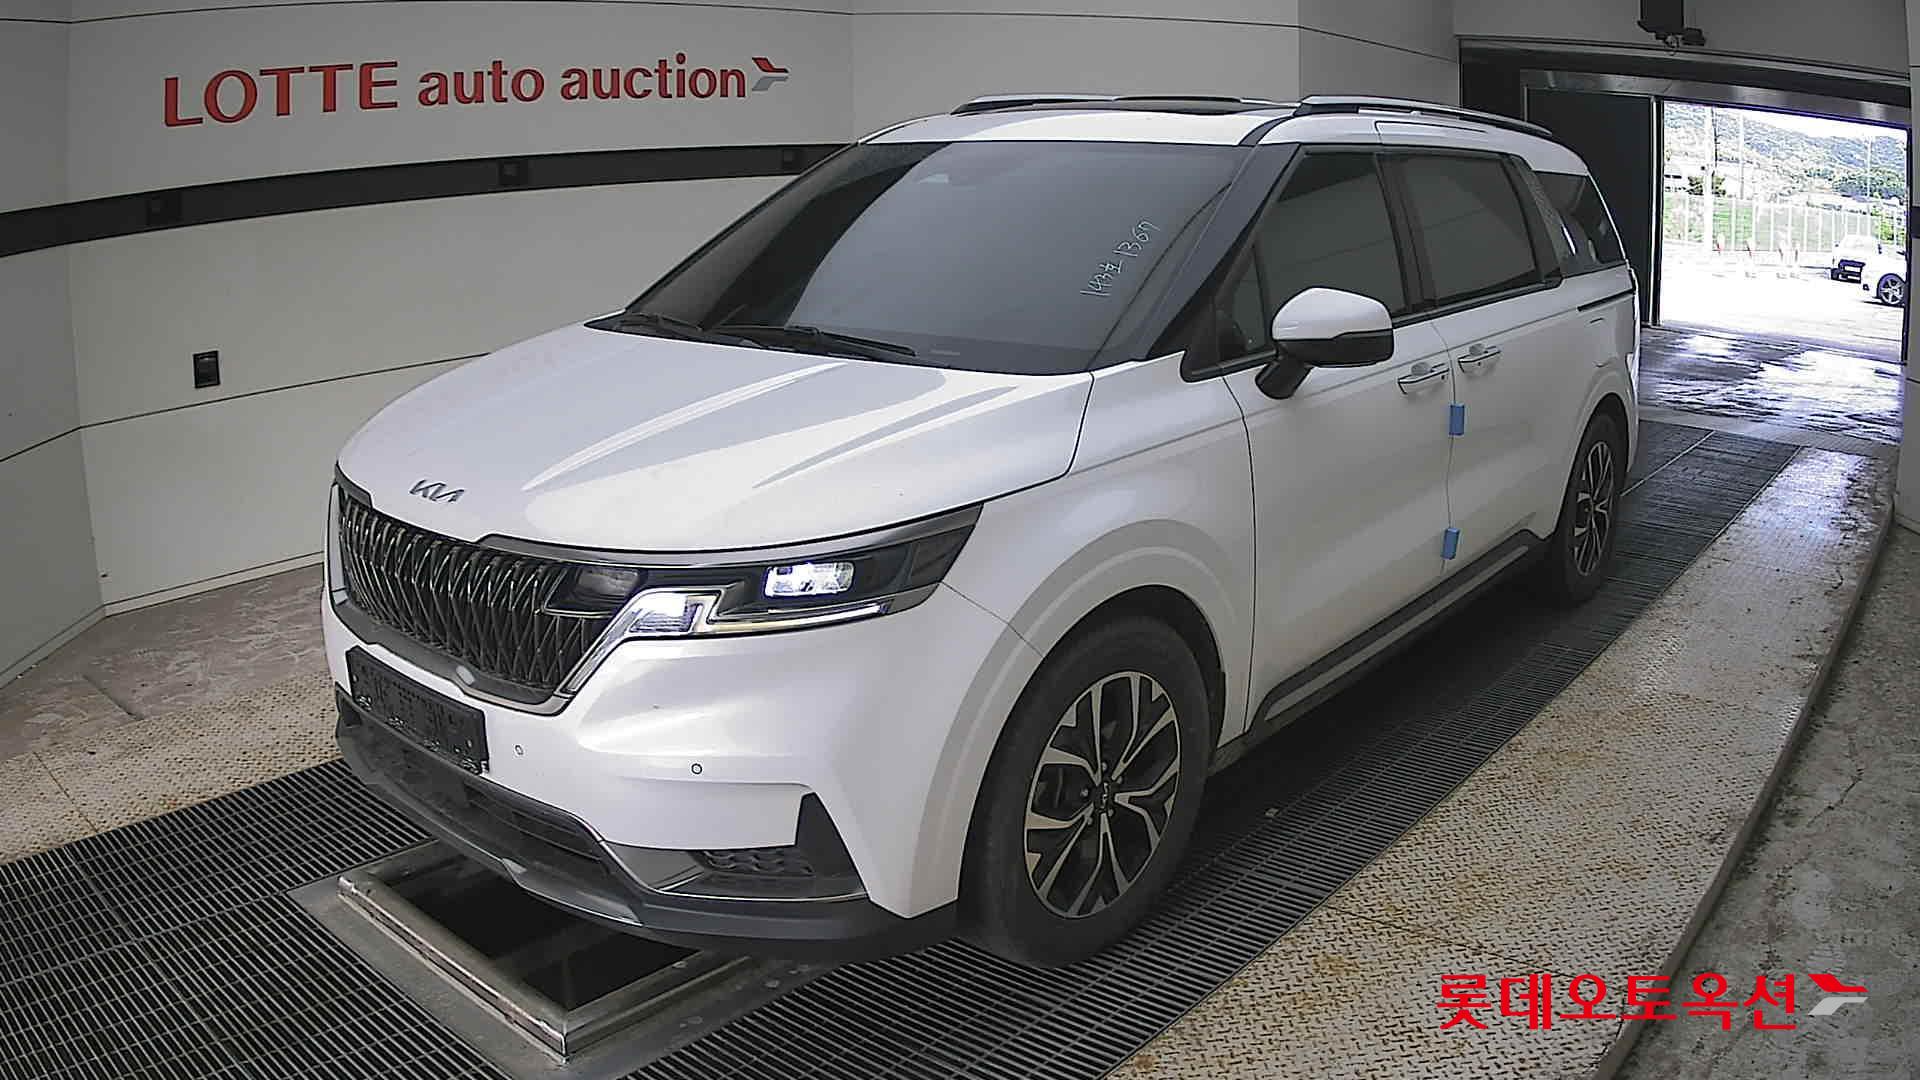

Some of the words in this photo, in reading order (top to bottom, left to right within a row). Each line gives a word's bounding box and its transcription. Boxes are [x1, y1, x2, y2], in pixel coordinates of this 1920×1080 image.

[164, 60, 399, 127] LOTTE
[417, 60, 545, 107] auto
[560, 53, 746, 101] auction
[1112, 219, 1161, 258] 1367
[409, 479, 465, 503] KIA
